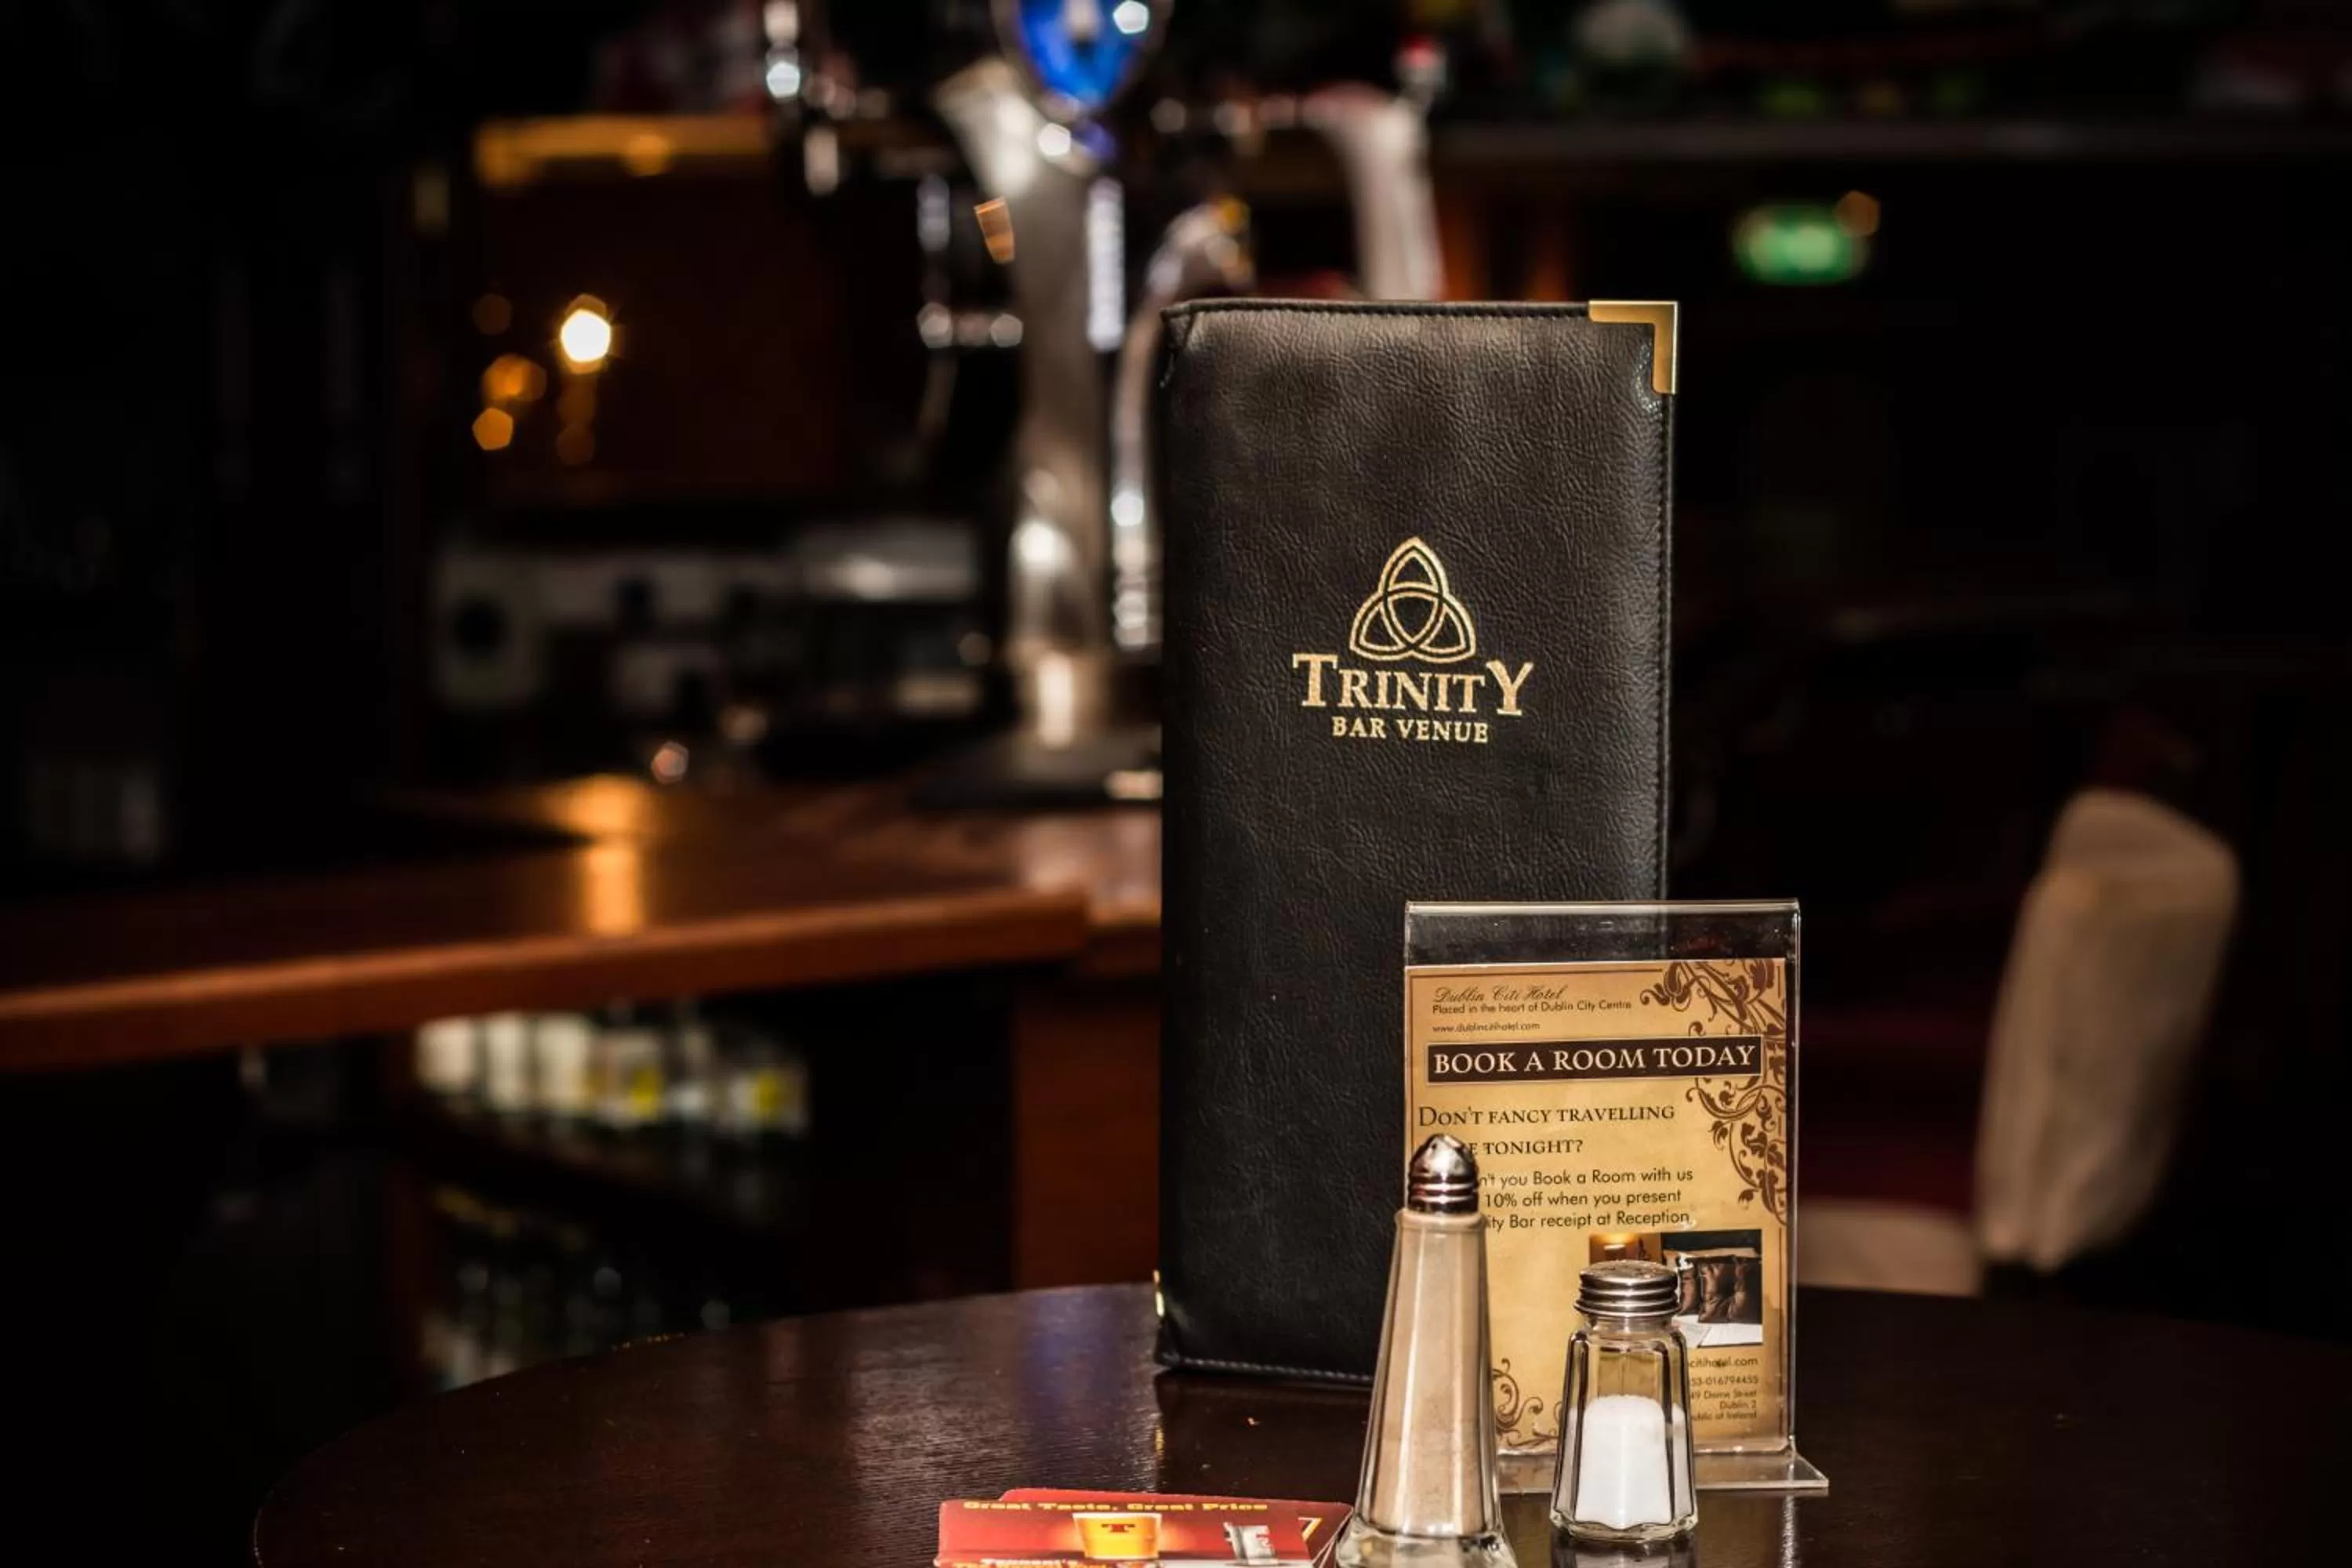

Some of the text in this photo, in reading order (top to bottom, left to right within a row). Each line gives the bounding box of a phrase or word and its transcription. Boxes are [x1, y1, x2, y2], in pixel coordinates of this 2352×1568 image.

[1293, 652, 1534, 716] TRINITY
[1332, 715, 1489, 743] BAR VENUE
[1432, 985, 1484, 1003] Dublin
[1524, 984, 1569, 1000] Hotel
[1432, 1004, 1465, 1014] Placed
[1468, 1004, 1478, 1014] in
[1480, 1003, 1495, 1013] the
[1499, 1003, 1524, 1013] heart
[1528, 1002, 1537, 1012] of
[1541, 1001, 1573, 1012] Dublin
[1577, 1000, 1595, 1012] City
[1434, 1045, 1755, 1074] BOOK A ROOM TODAY
[1418, 1105, 1675, 1127] DON'T FANCY TRAVELLING
[1483, 1138, 1584, 1155] TONIGHT?
[1479, 1166, 1693, 1189] n't you Book a Room with us
[1485, 1189, 1681, 1208] 10% off when you present
[1509, 1214, 1534, 1229] Bar
[1540, 1212, 1592, 1230] receipt
[1596, 1212, 1610, 1225] at
[1616, 1208, 1690, 1228] Reception
[1689, 1356, 1759, 1368] citihotel.com
